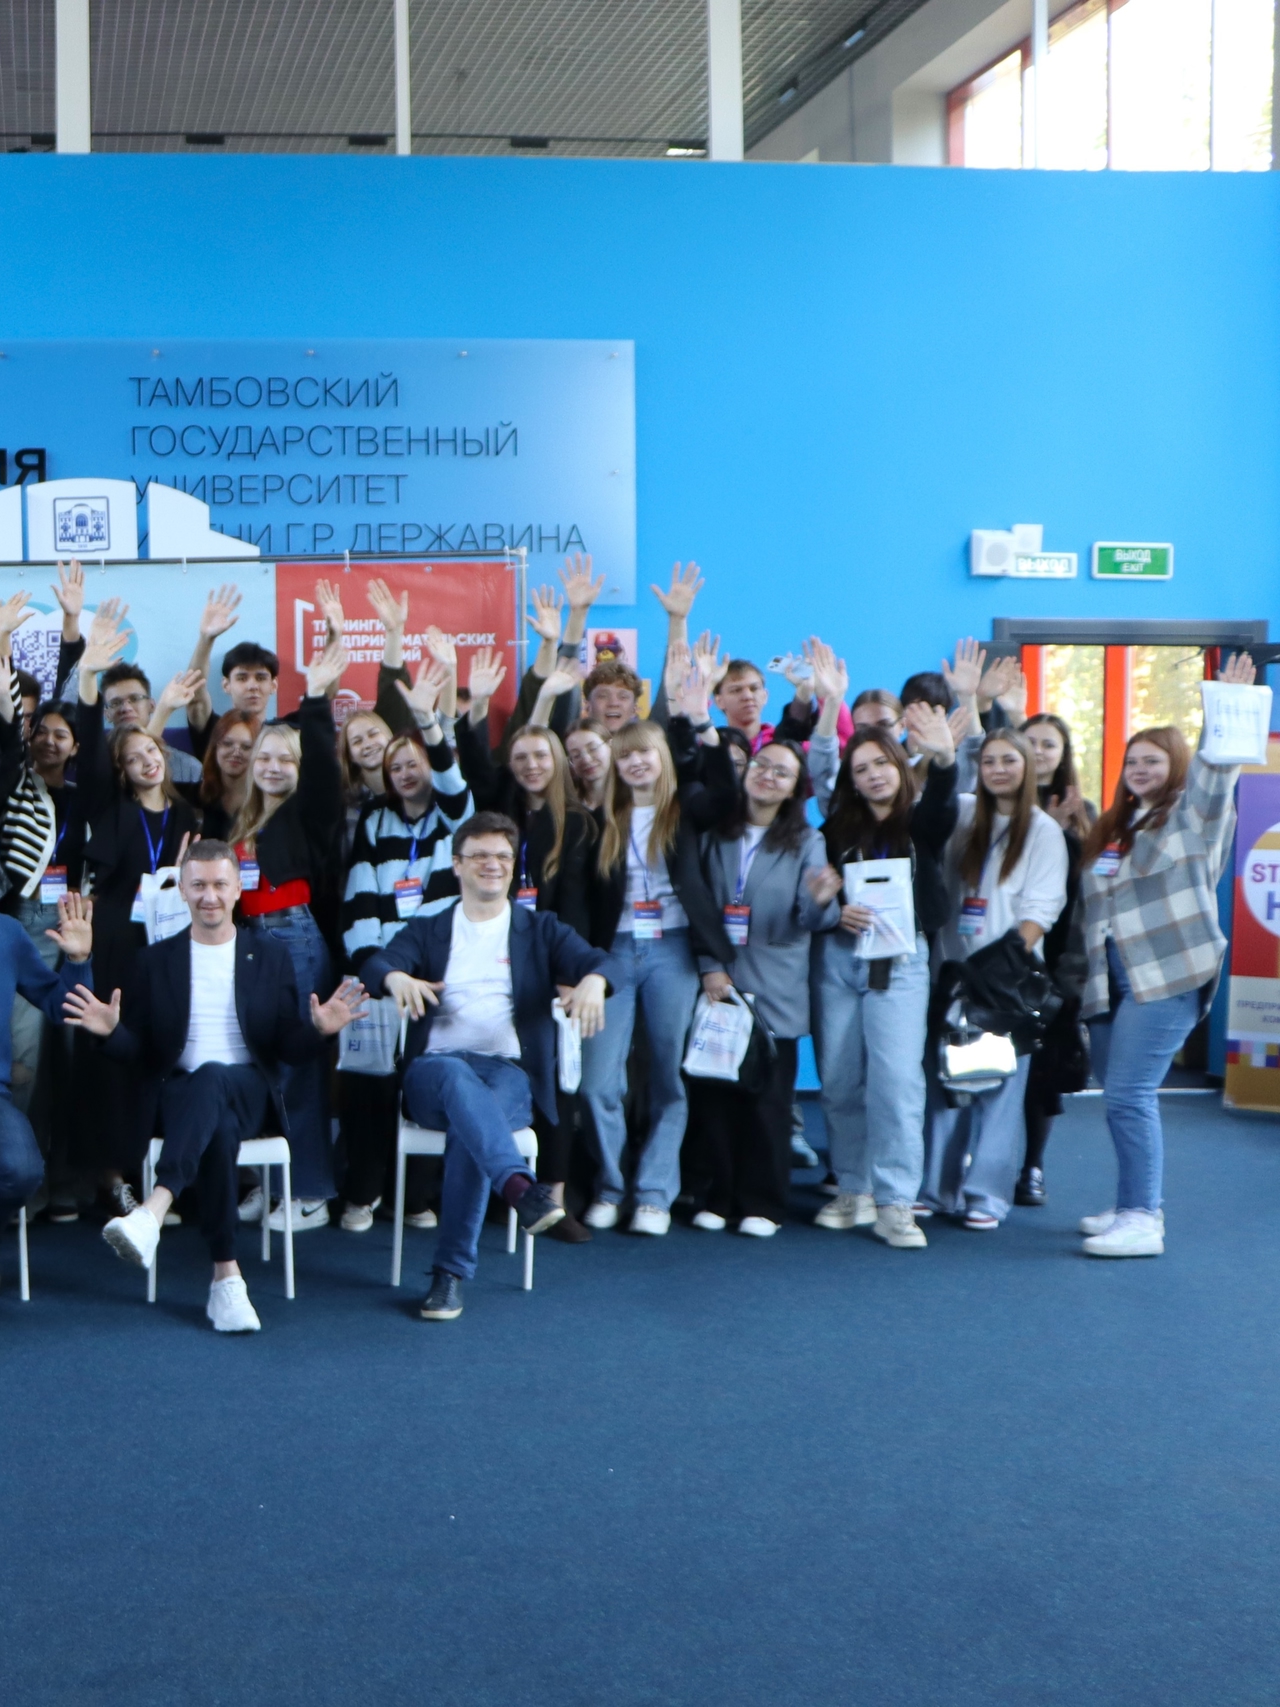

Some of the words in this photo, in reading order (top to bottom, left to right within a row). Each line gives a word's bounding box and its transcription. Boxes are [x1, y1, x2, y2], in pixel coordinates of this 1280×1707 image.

[128, 371, 400, 408] ТАМБОВСКИЙ
[131, 420, 519, 461] ГОСУДАРСТВЕННЫЙ
[130, 473, 409, 505] УИВЕРСИТЕТ
[348, 523, 588, 553] ДЕРЖАВИНА
[1017, 557, 1070, 573] ВЫХОД
[1115, 548, 1152, 563] ВЫХОД
[1122, 562, 1146, 573] EXIT
